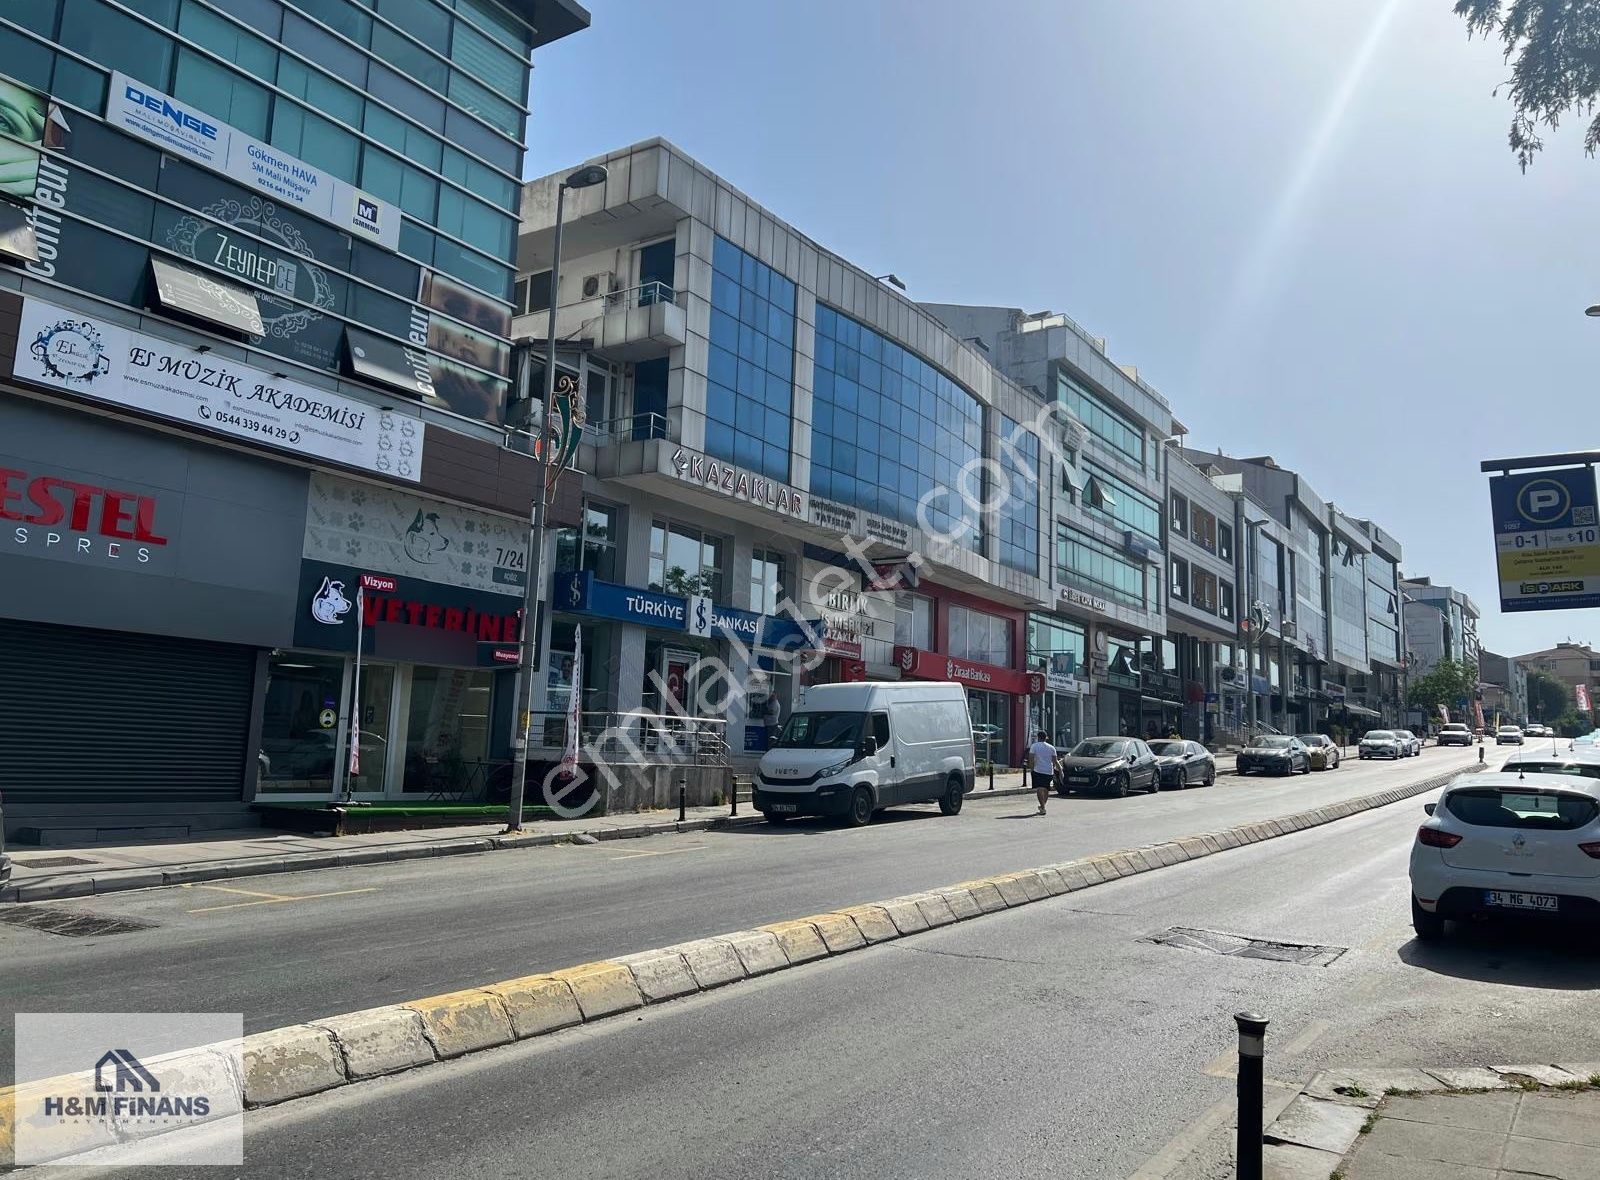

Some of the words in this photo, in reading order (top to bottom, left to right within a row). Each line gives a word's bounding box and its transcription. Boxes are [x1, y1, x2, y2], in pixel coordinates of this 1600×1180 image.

[125, 86, 217, 140] DENGE
[247, 145, 289, 173] Gökmen
[292, 165, 318, 186] HAVA
[252, 162, 264, 174] SM
[283, 177, 311, 195] Müşavir
[258, 177, 274, 189] 0216
[157, 356, 242, 397] MÜZİK
[246, 384, 366, 430] AKADEMİSİ
[215, 411, 240, 427] 0544
[242, 418, 260, 432] 339
[261, 424, 273, 436] 44
[275, 427, 287, 439] 29
[691, 456, 802, 514] KAZAKLAR
[1530, 489, 1559, 513] P
[1515, 534, 1538, 548] 0-1
[496, 547, 524, 569] 7/24
[363, 575, 394, 589] Vizyon
[363, 594, 519, 643] VETERİNE
[626, 595, 684, 621] TÜRKİYE
[711, 614, 760, 635] BANKASI
[954, 665, 970, 679] Ziraat
[1491, 891, 1503, 902] 34
[1530, 895, 1557, 908] 4073
